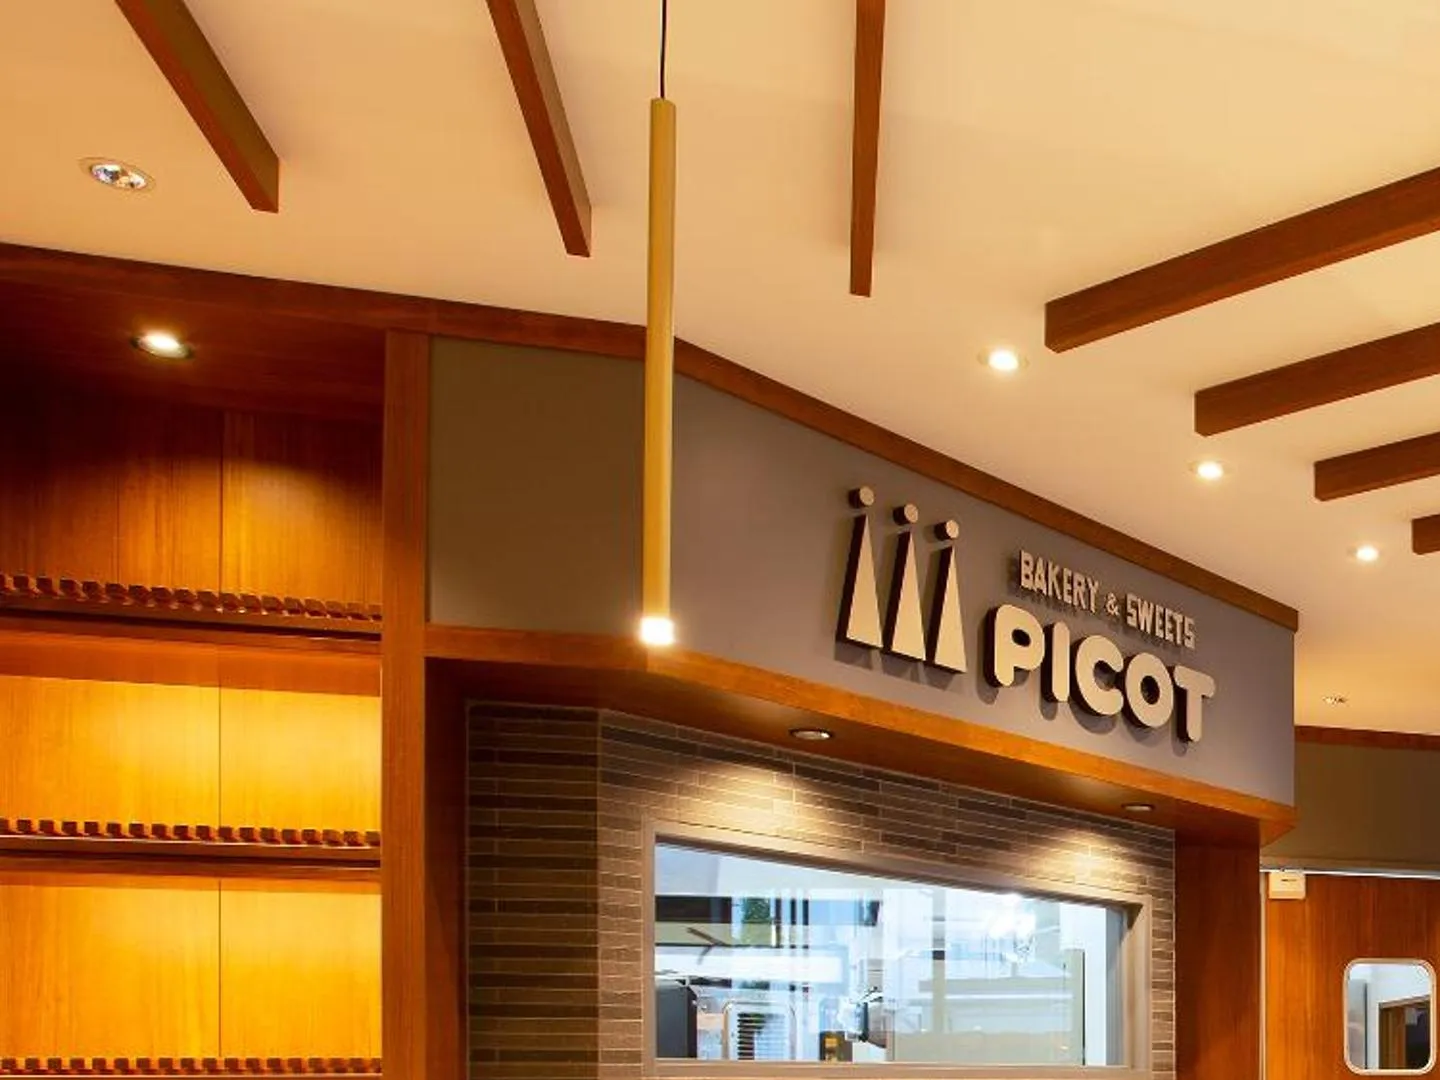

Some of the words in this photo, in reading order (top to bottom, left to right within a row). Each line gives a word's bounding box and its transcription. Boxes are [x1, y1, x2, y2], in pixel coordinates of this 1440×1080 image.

[1019, 550, 1099, 613] BAKERY
[1104, 592, 1120, 616] &
[1126, 593, 1197, 649] SWEETS
[990, 604, 1215, 743] PICOT
